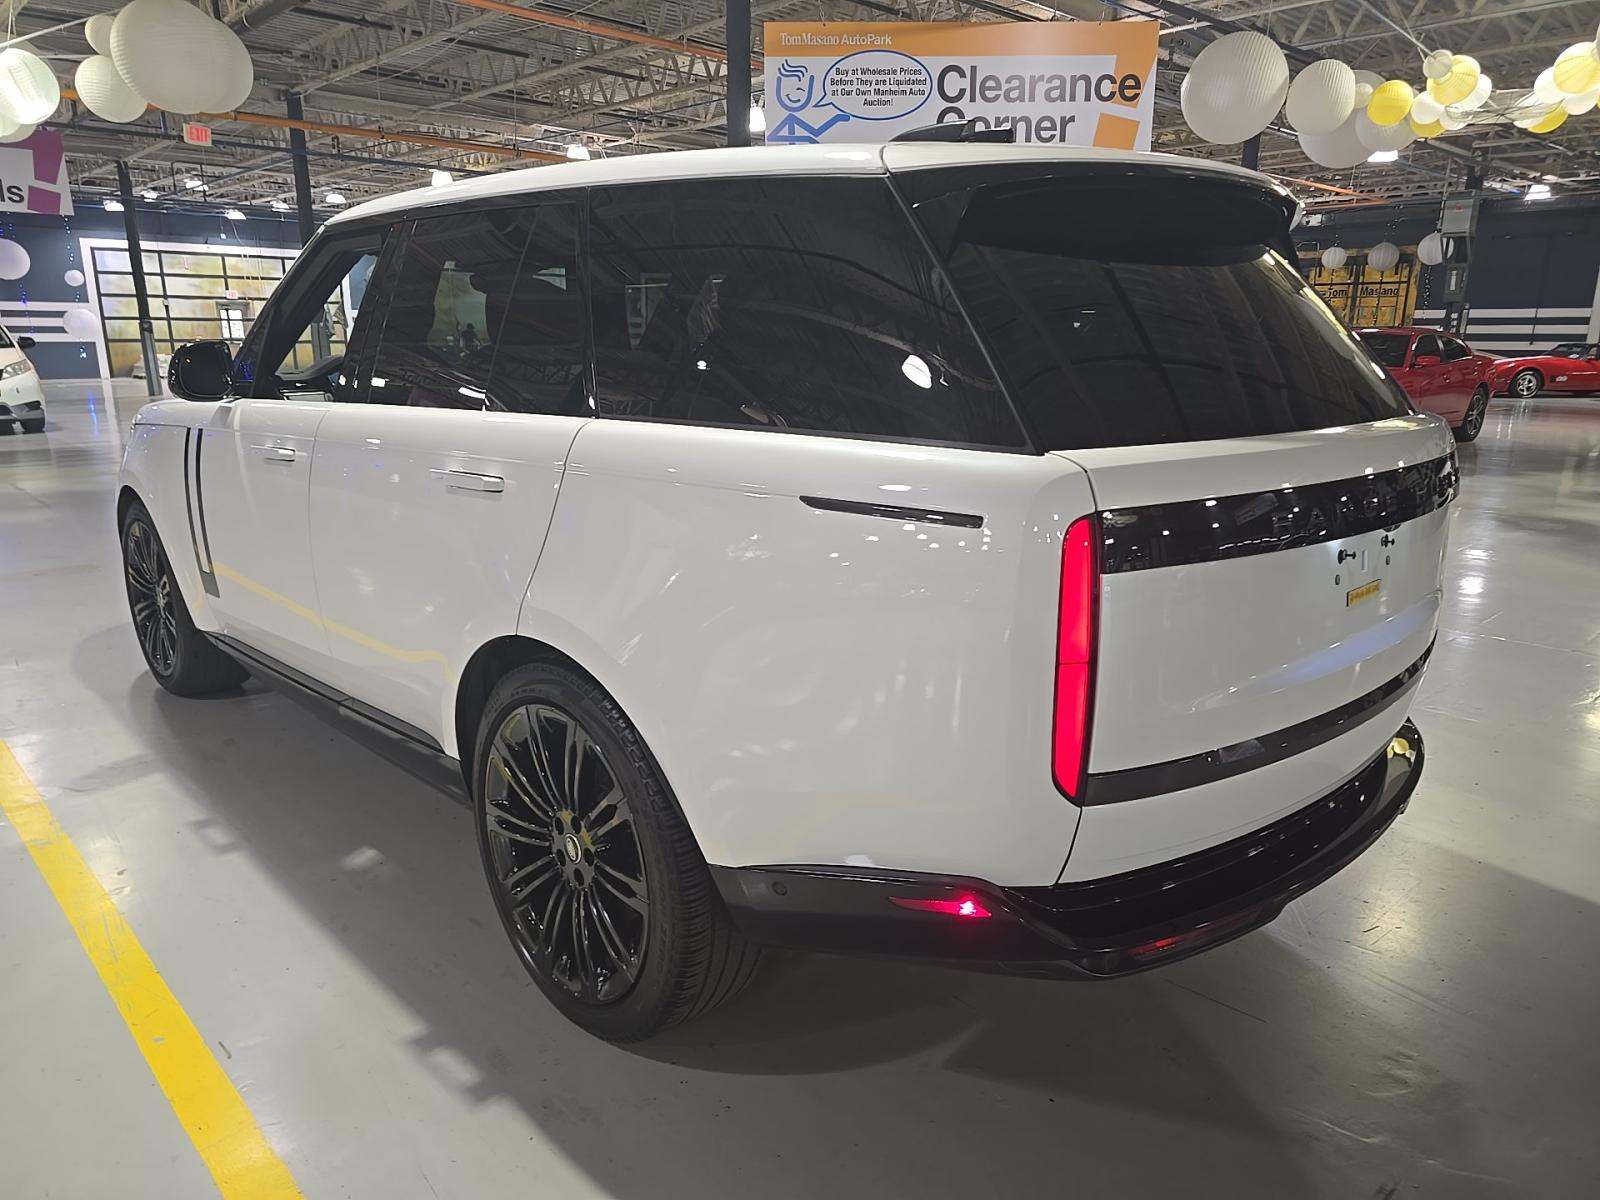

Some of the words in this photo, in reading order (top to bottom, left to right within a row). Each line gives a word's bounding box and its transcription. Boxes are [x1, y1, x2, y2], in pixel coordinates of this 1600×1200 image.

[841, 33, 892, 45] AutoPark
[835, 67, 849, 77] Buy
[851, 67, 859, 76] at
[860, 67, 898, 76] Wholesale
[899, 67, 922, 76] Prices
[830, 77, 854, 86] Before
[855, 77, 873, 87] They
[888, 77, 927, 87] Liquidated
[937, 64, 1141, 103] Clearance
[831, 88, 839, 96] at
[840, 88, 853, 96] Our
[855, 88, 872, 96] Own
[873, 87, 907, 96] Manheim
[908, 88, 926, 96] Auto
[863, 98, 894, 107] Auction!
[1360, 286, 1399, 296] Masano
